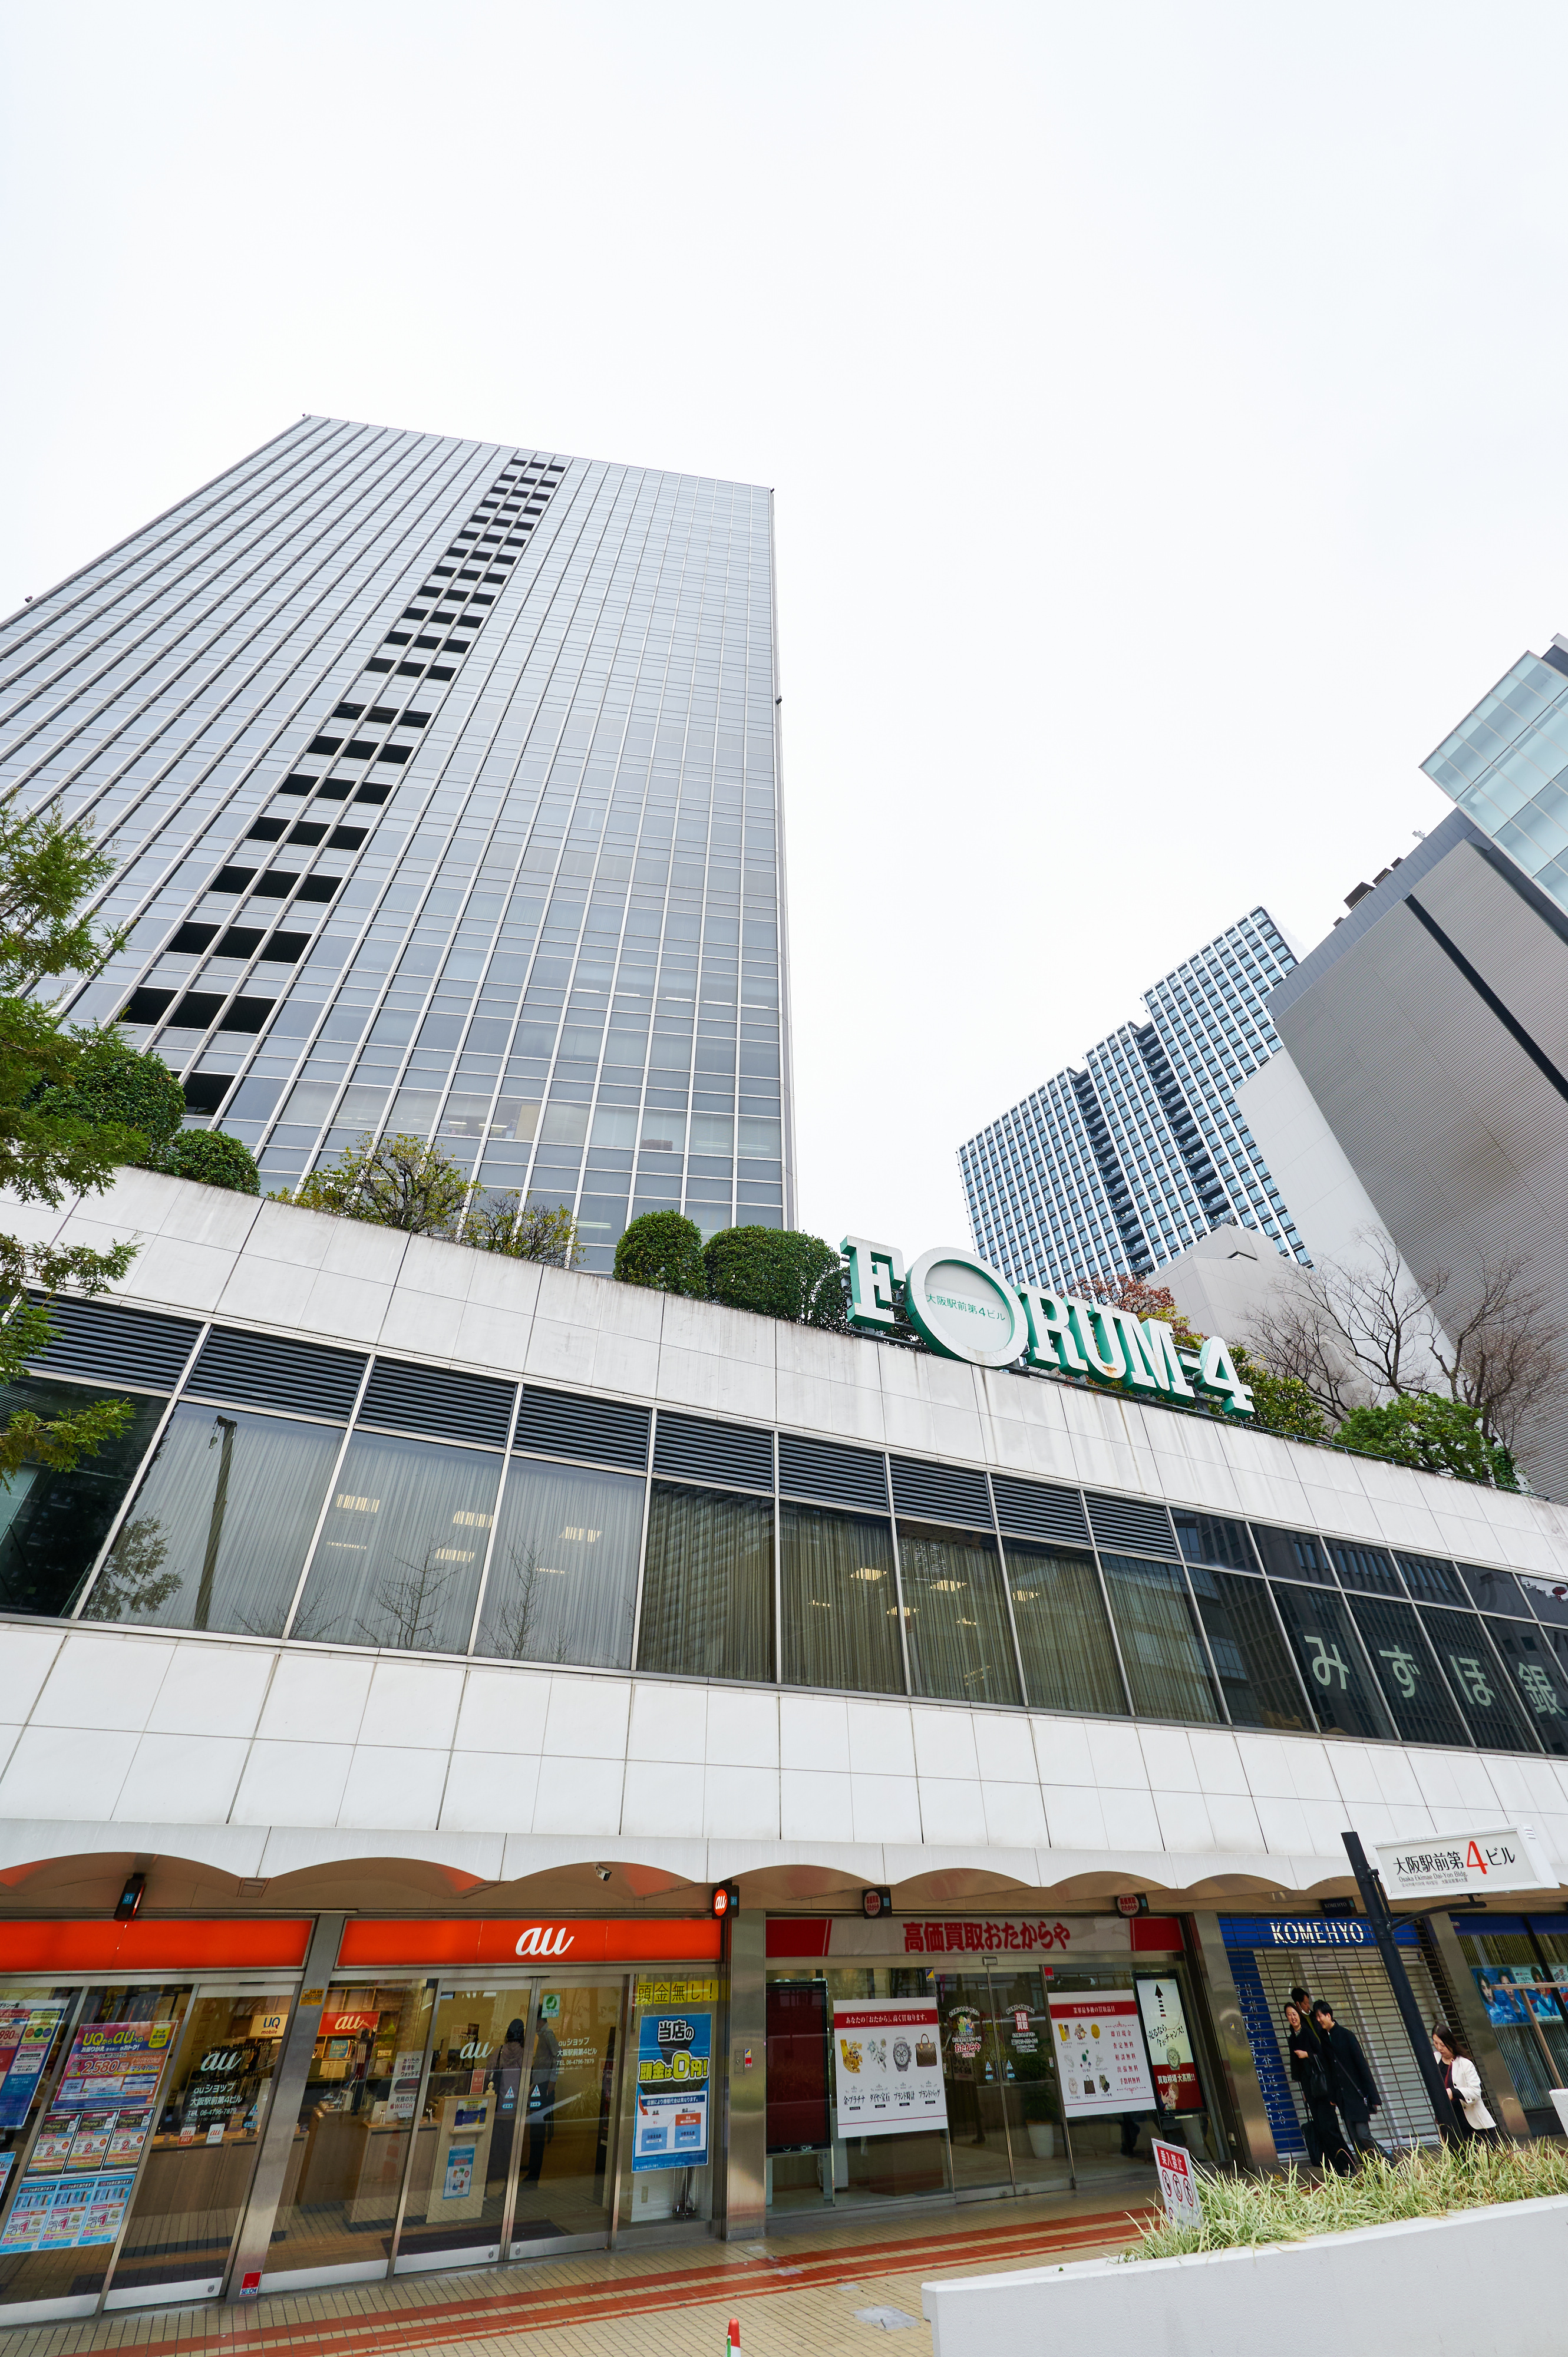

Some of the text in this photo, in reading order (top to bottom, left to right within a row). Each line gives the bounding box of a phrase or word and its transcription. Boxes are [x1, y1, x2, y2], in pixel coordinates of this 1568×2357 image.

[926, 1293, 1005, 1321] 大阪駅前第4ビル
[1304, 1635, 1566, 1716] みずほ銀
[1393, 1840, 1515, 1875] 大阪駅前第4ビル
[715, 1895, 727, 1910] au
[903, 1921, 1071, 1953] 高価買取おたからや
[1269, 1922, 1364, 1944] KOMEHYO
[515, 1927, 575, 1956] au
[263, 2016, 280, 2029] UQ
[335, 2016, 364, 2030] au
[846, 2013, 927, 2024] あなたの「おたから」、高く買取ります。
[658, 2019, 695, 2042] 当店の
[1147, 2024, 1167, 2041] 売るなら
[1157, 2026, 1184, 2048] 今がチャンス!
[558, 2036, 590, 2046] auショップ
[955, 2042, 981, 2053] おたからや
[1113, 2041, 1134, 2049] 査定無料
[460, 2042, 494, 2059] au
[557, 2048, 598, 2057] 大阪駅前第4ビル
[200, 2052, 242, 2071] au
[638, 2050, 710, 2083] 頭金は0円!
[1117, 2065, 1138, 2073] 出張無料
[1120, 2077, 1141, 2085] 手数料無料
[193, 2082, 235, 2094] auショップ
[918, 2089, 940, 2098] ブランドバッグ
[190, 2095, 242, 2106] 大阪駅前第4ビル
[870, 2092, 890, 2102] ダイヤ・宝石
[893, 2091, 915, 2101] ブランド時計
[200, 2108, 236, 2116] 06-4796-7879
